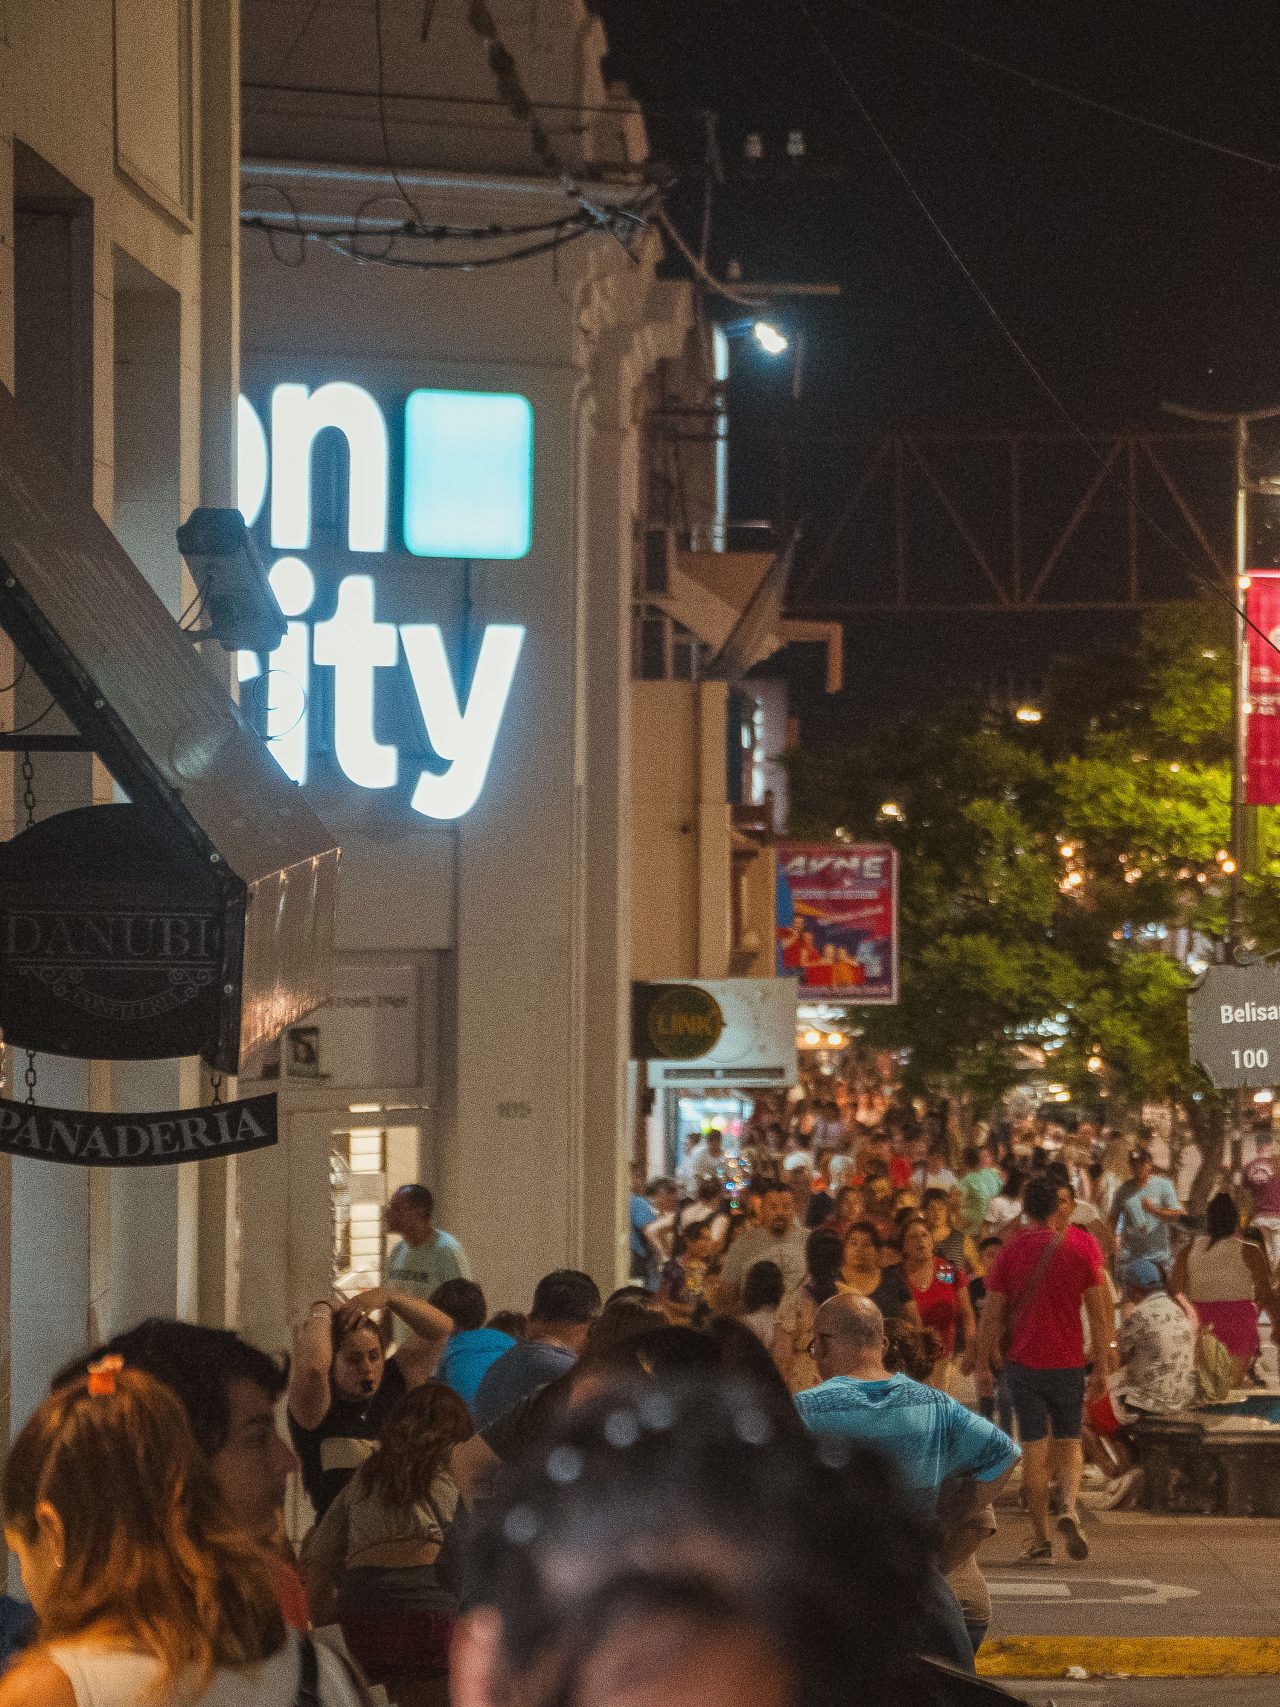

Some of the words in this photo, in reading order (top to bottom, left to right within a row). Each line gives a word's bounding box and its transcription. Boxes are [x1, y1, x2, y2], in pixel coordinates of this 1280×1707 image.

[238, 382, 390, 553] n
[238, 556, 527, 820] ity
[4, 916, 220, 958] DANUBI
[1231, 1048, 1269, 1069] 100
[0, 1106, 268, 1159] PANADERIA
